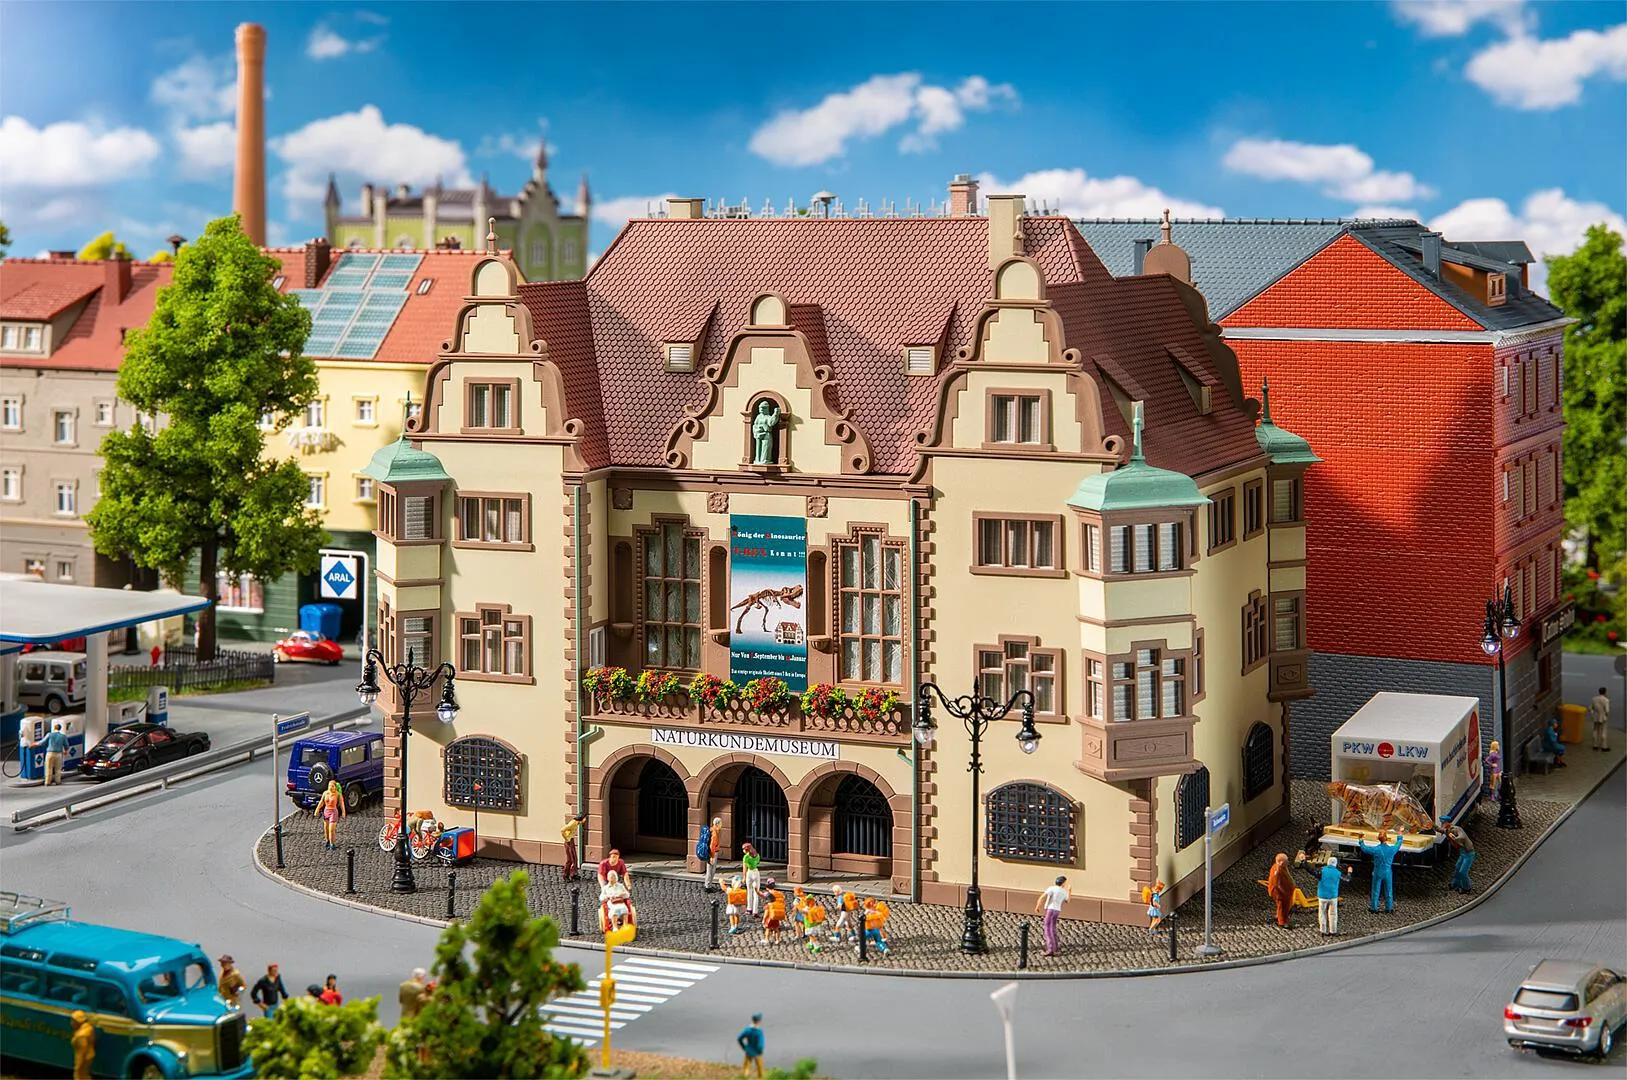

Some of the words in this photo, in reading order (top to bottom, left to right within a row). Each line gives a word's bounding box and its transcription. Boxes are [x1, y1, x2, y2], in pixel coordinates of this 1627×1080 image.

[329, 573, 350, 582] ARAL
[655, 728, 836, 757] NATURKUNDEMUSEUM
[1343, 742, 1374, 754] PKW
[1398, 745, 1428, 758] LKW
